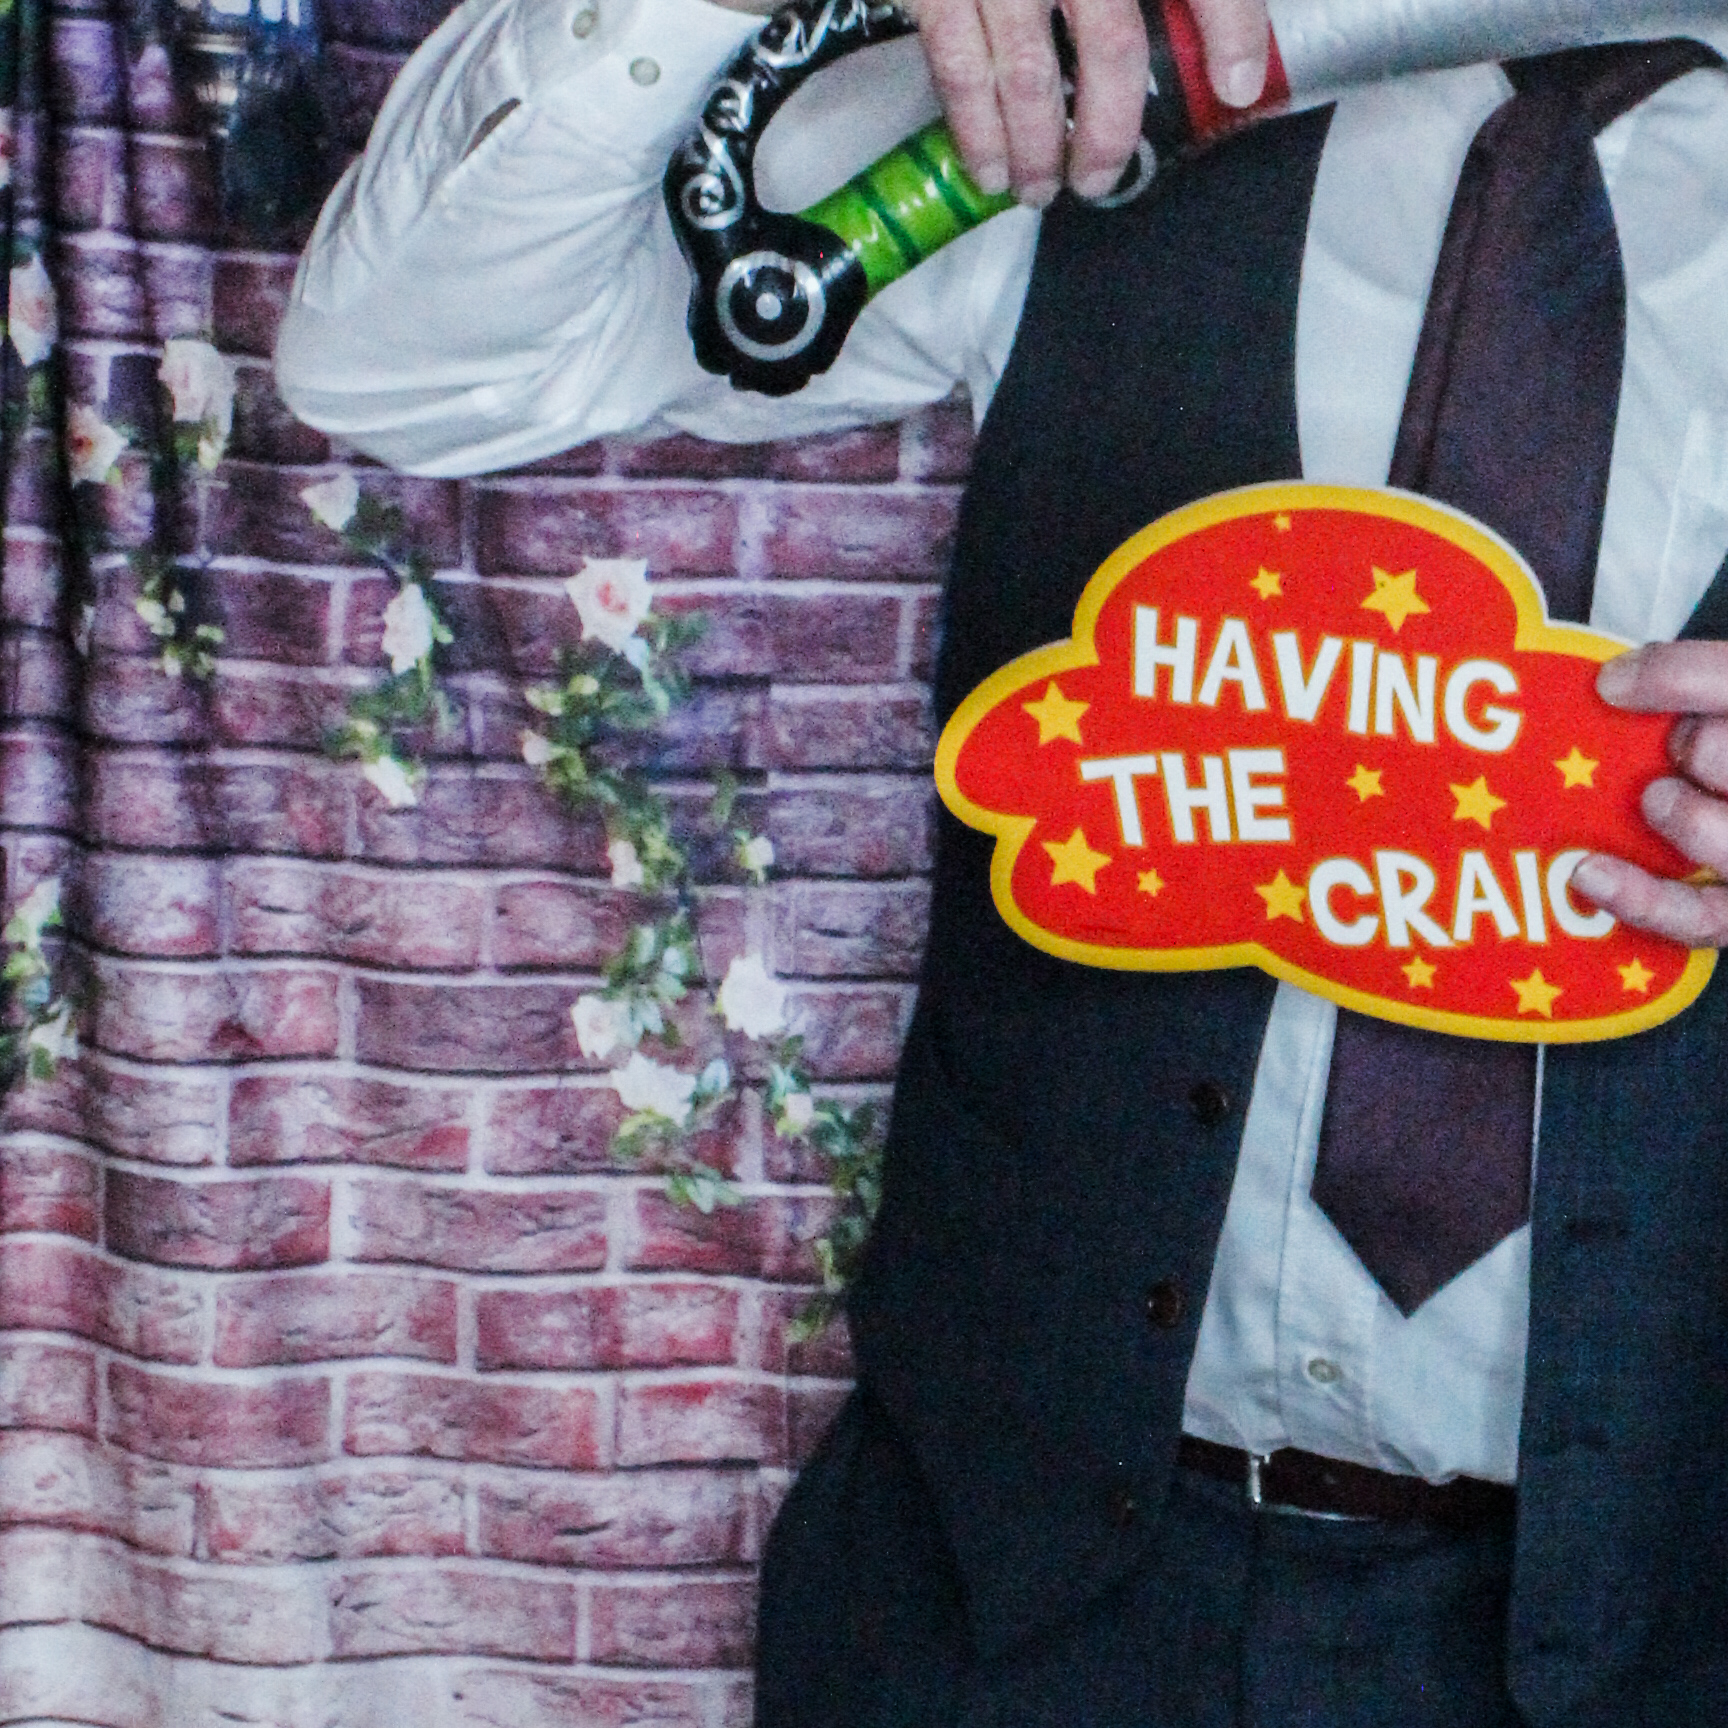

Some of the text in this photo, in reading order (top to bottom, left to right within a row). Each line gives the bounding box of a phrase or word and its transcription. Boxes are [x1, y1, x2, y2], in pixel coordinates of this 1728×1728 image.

[1131, 603, 1523, 754] HAVING
[1080, 748, 1292, 848] THE
[1307, 848, 1616, 949] CRAIC
